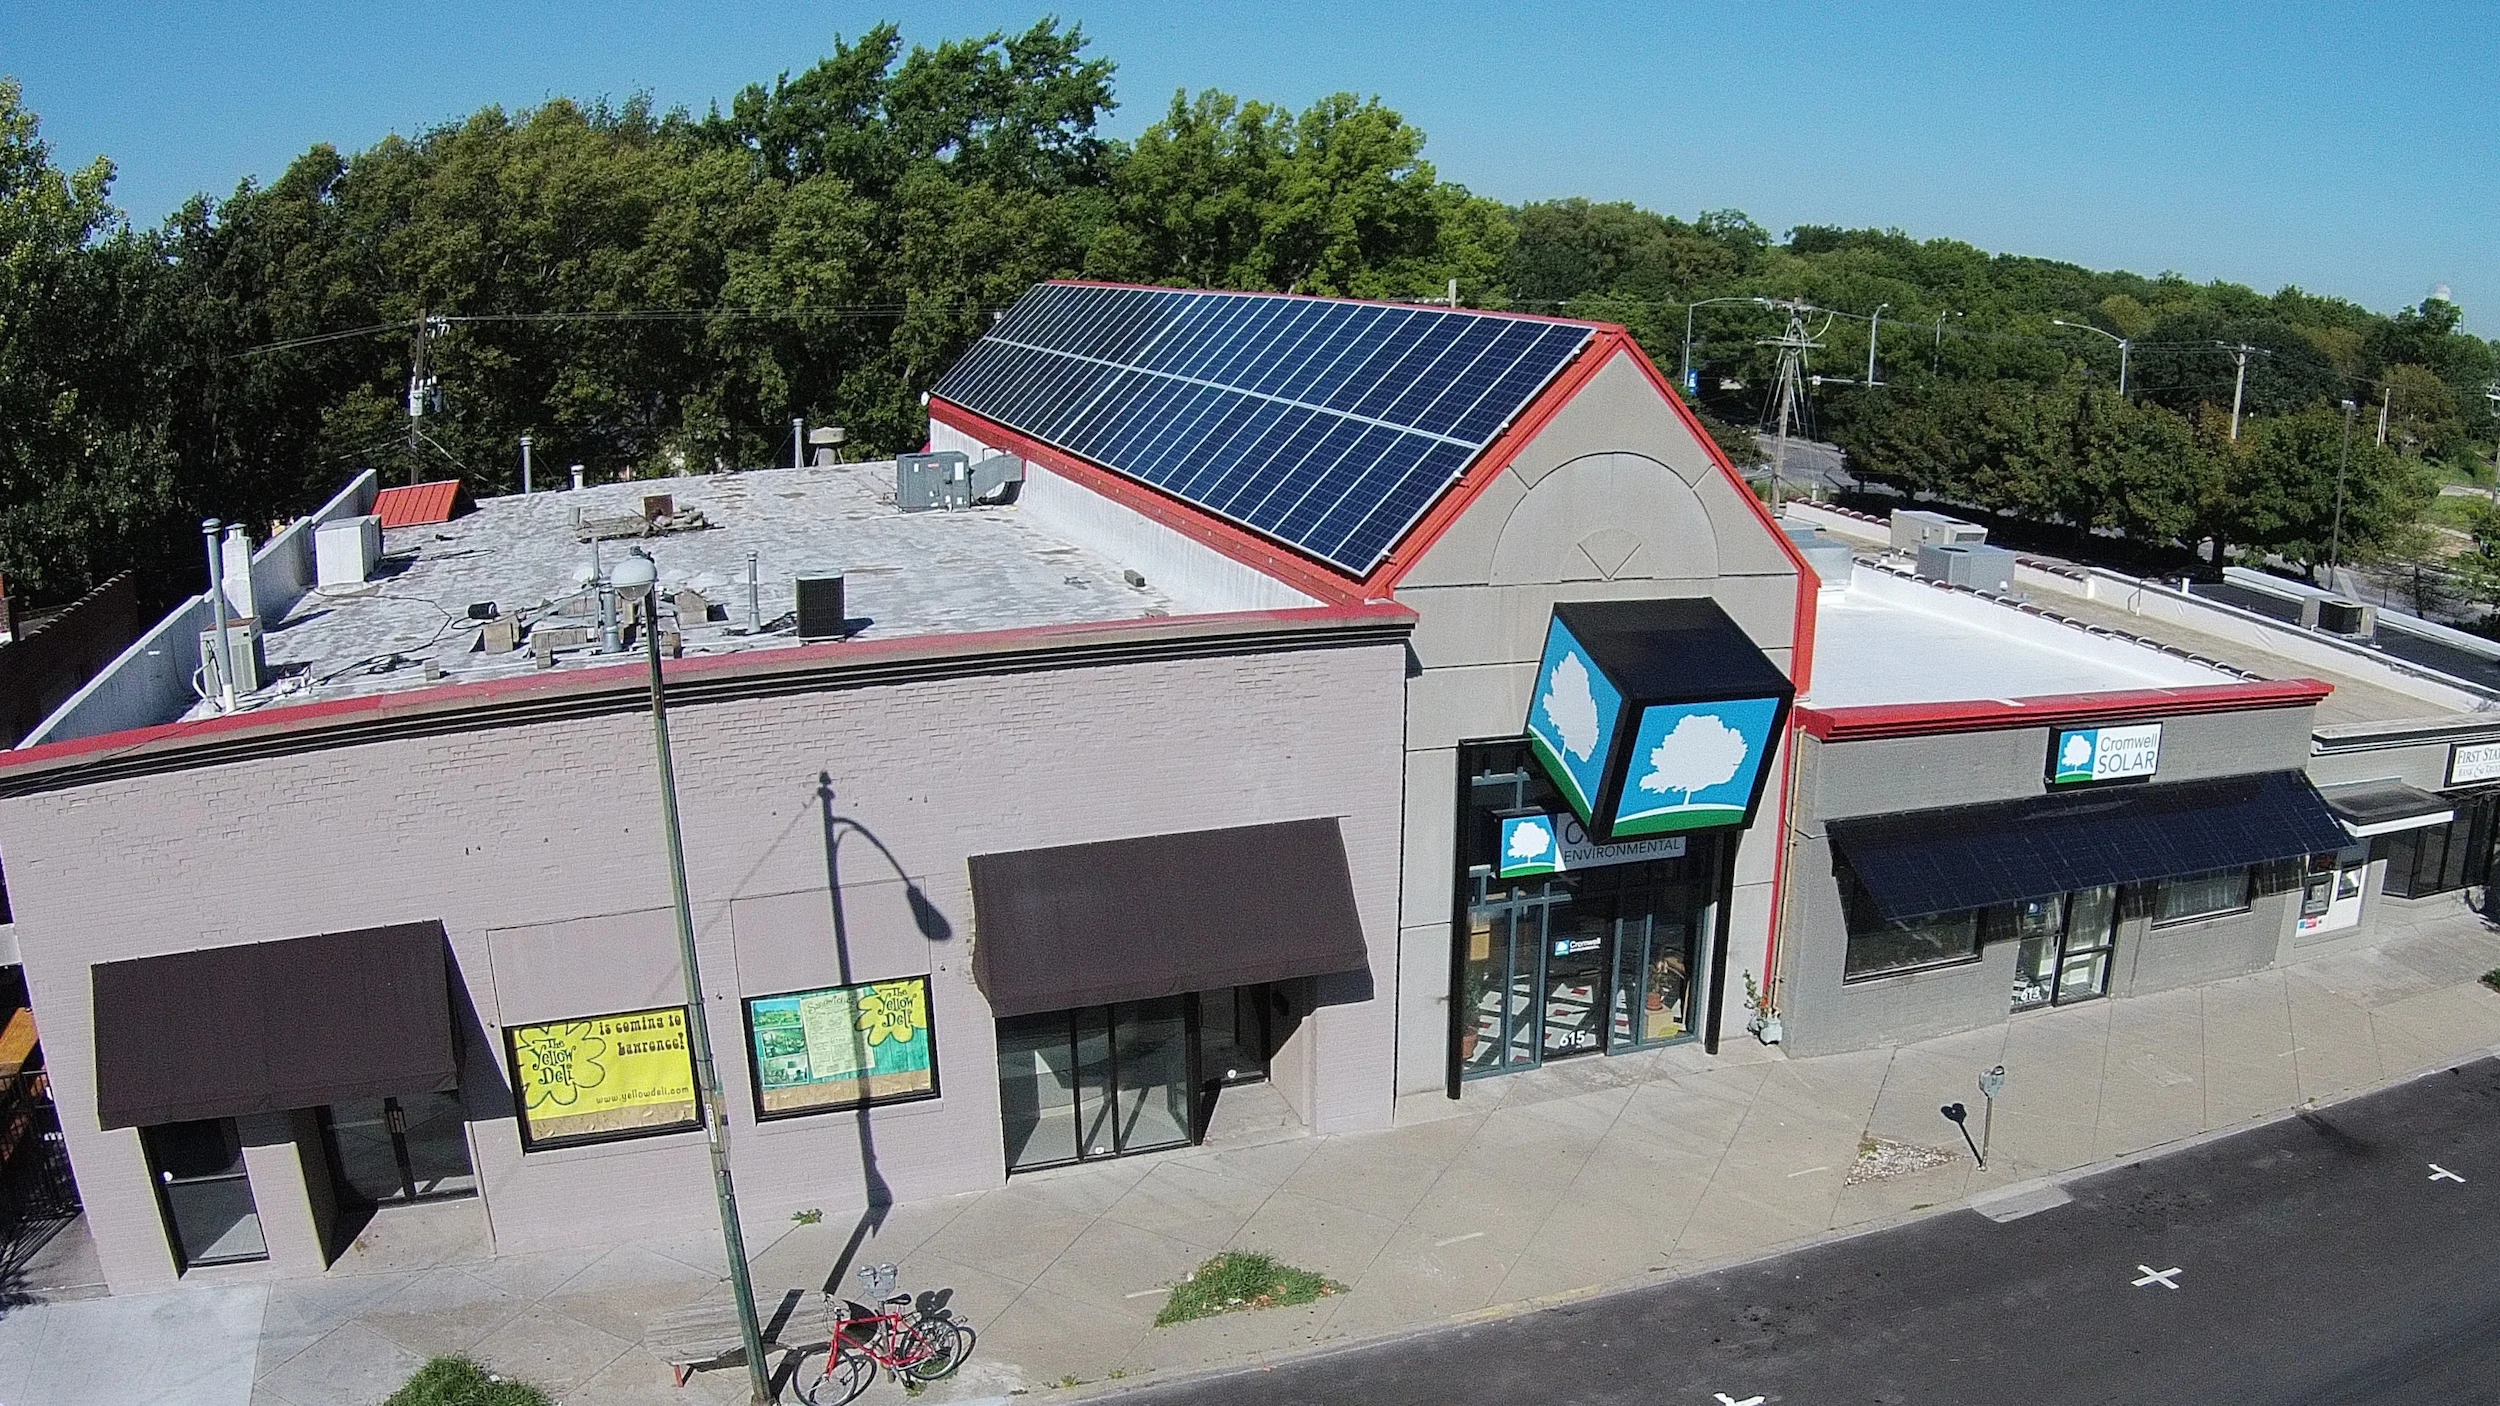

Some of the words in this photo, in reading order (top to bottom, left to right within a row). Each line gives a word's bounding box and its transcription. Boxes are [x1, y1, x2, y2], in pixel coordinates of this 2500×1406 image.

[2100, 733, 2158, 752] Cromwell
[2098, 751, 2155, 774] SOLAR
[2457, 750, 2481, 764] FIRST
[1564, 838, 1680, 862] ENVIRONMENTAL
[878, 987, 908, 997] The
[2021, 986, 2040, 1000] 613
[876, 993, 917, 1015] Yellow
[599, 1022, 611, 1035] is
[615, 1016, 664, 1033] coming
[669, 1014, 682, 1026] to
[882, 1008, 913, 1028] Deli
[532, 1038, 565, 1049] The
[617, 1032, 685, 1056] Lawrence!
[1560, 1030, 1585, 1047] 615
[530, 1045, 576, 1070] Yellow
[538, 1064, 574, 1086] Deli
[596, 1086, 689, 1104] www.yellowdeli.com
